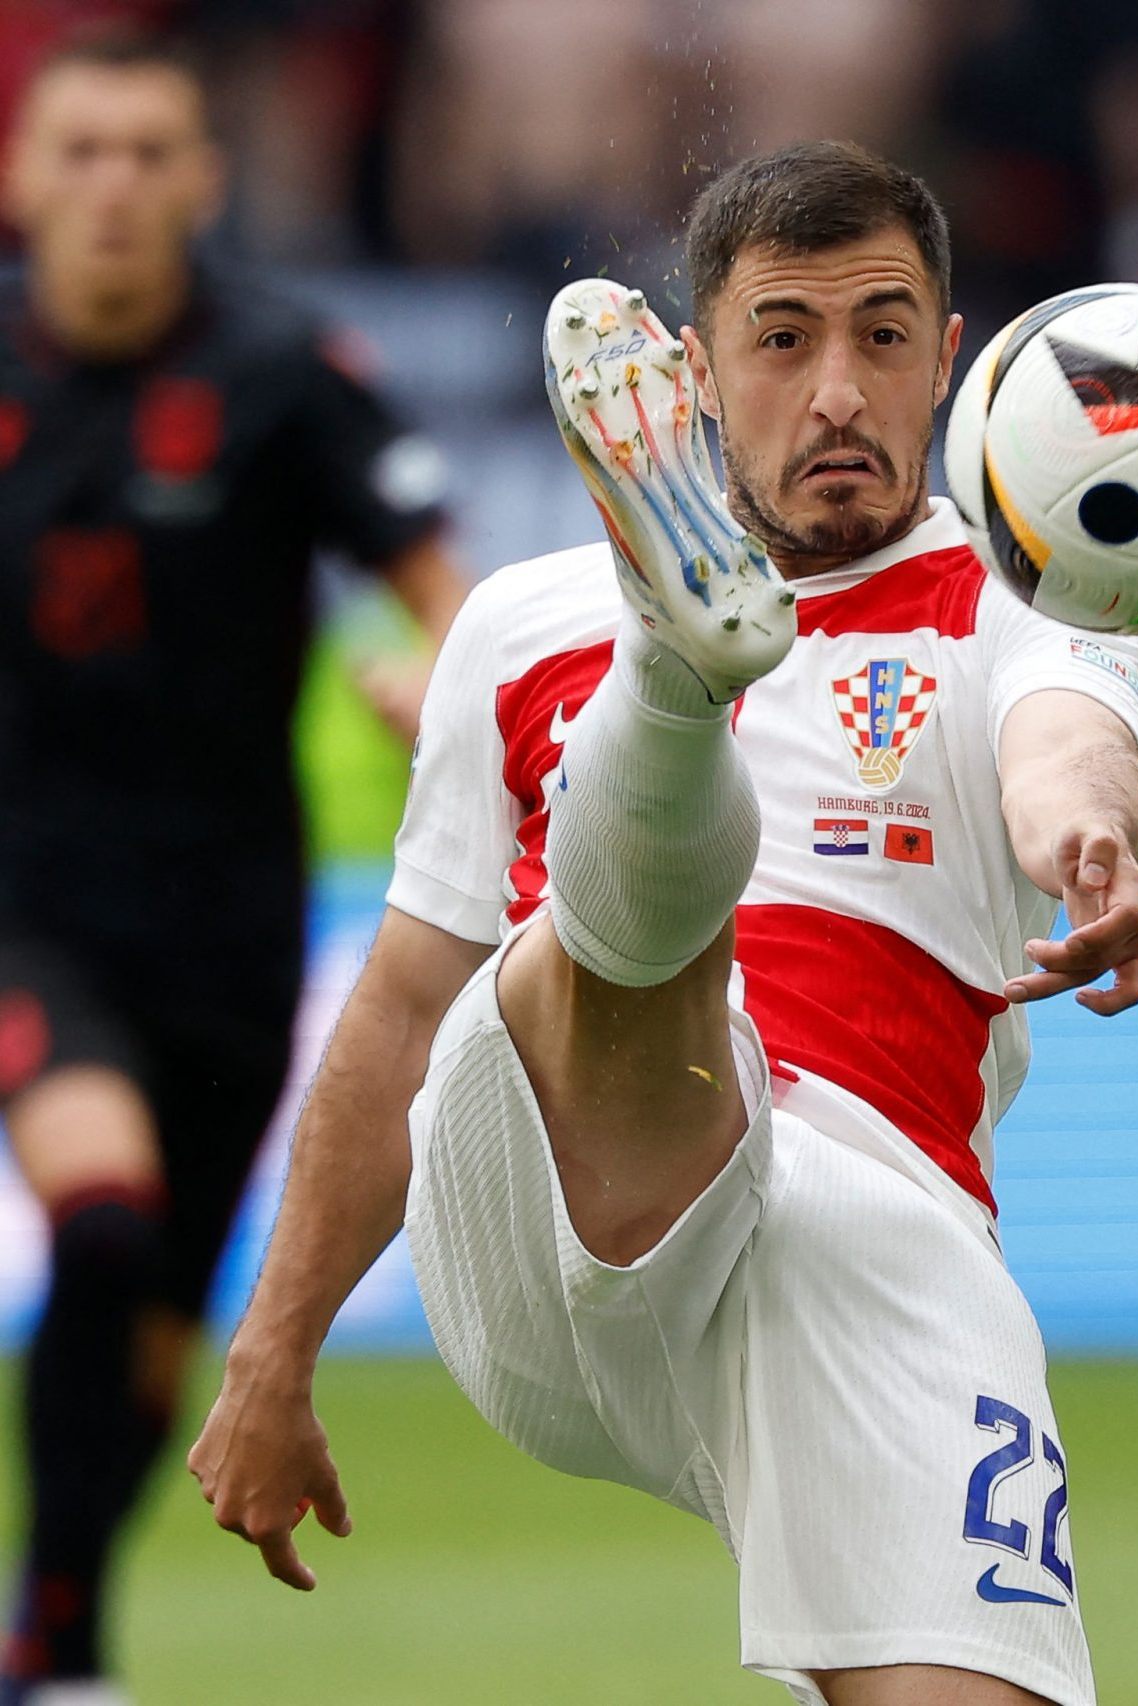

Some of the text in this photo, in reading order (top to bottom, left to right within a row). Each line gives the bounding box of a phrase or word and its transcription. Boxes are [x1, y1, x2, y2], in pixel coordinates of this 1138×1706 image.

[585, 338, 647, 368] F50
[1070, 637, 1101, 651] UEFA
[875, 668, 895, 735] HNS
[963, 1395, 1074, 1601] 22
